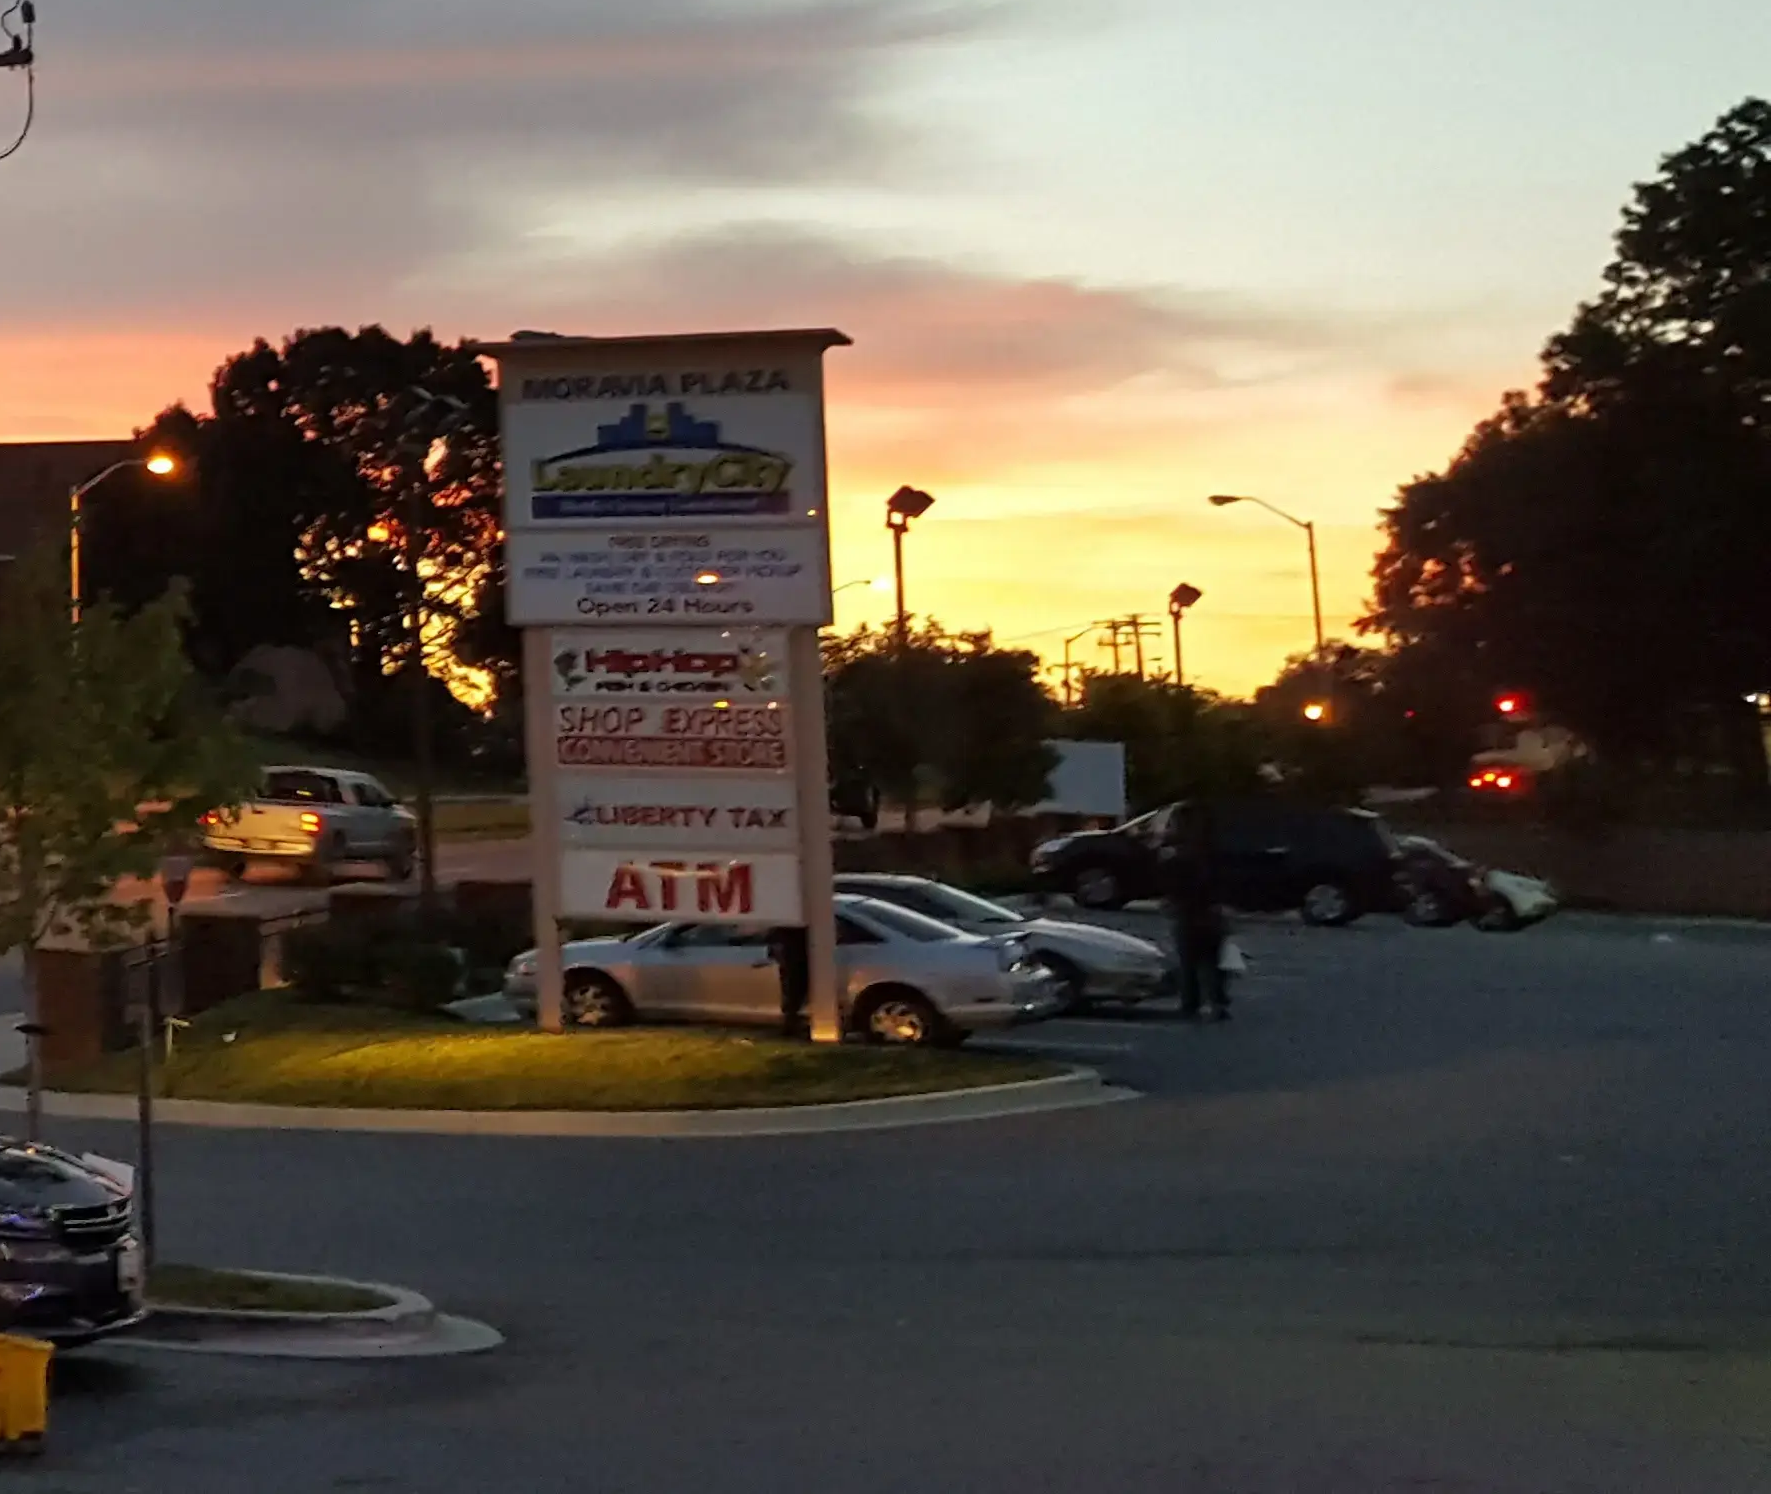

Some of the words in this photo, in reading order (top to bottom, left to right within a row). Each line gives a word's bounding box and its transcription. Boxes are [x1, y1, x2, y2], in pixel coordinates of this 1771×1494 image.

[522, 373, 667, 401] MORAVIA
[680, 368, 790, 395] PLAZA
[576, 596, 638, 618] Open
[647, 597, 676, 615] 24
[684, 596, 755, 615] Hours
[560, 706, 646, 735] SHOP
[662, 706, 784, 737] EXPRESS
[596, 805, 717, 829] LIBERTY
[726, 806, 788, 829] TAX
[604, 860, 755, 915] ATM
